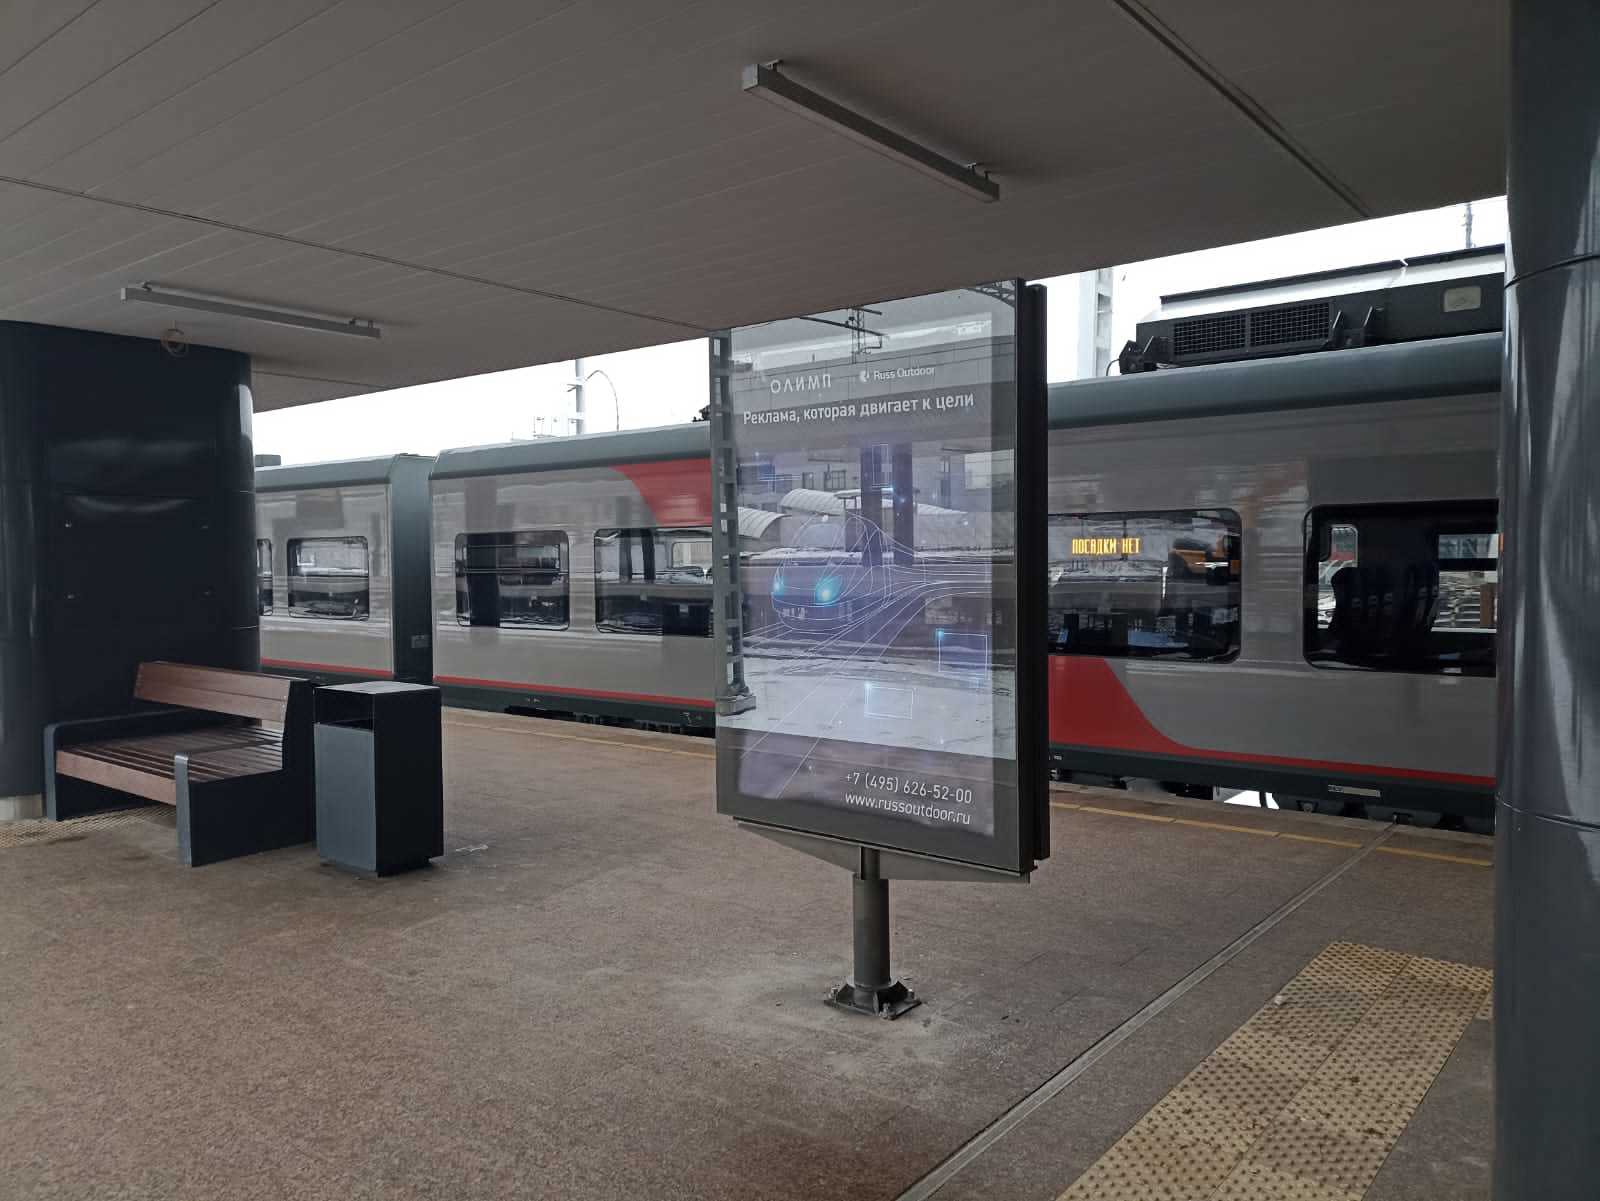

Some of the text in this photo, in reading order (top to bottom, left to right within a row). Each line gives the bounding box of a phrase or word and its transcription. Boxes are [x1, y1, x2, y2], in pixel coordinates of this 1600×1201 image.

[770, 373, 831, 394] ОЛИМП
[874, 367, 936, 381] Russ Outdoor
[743, 392, 974, 425] Реклама, которая двигает к цели
[1072, 537, 1140, 555] ПОСАДКИ НЕТ
[846, 772, 973, 804] +7 (495) 626-52-00
[845, 792, 971, 825] www.russoutdoor.ru
